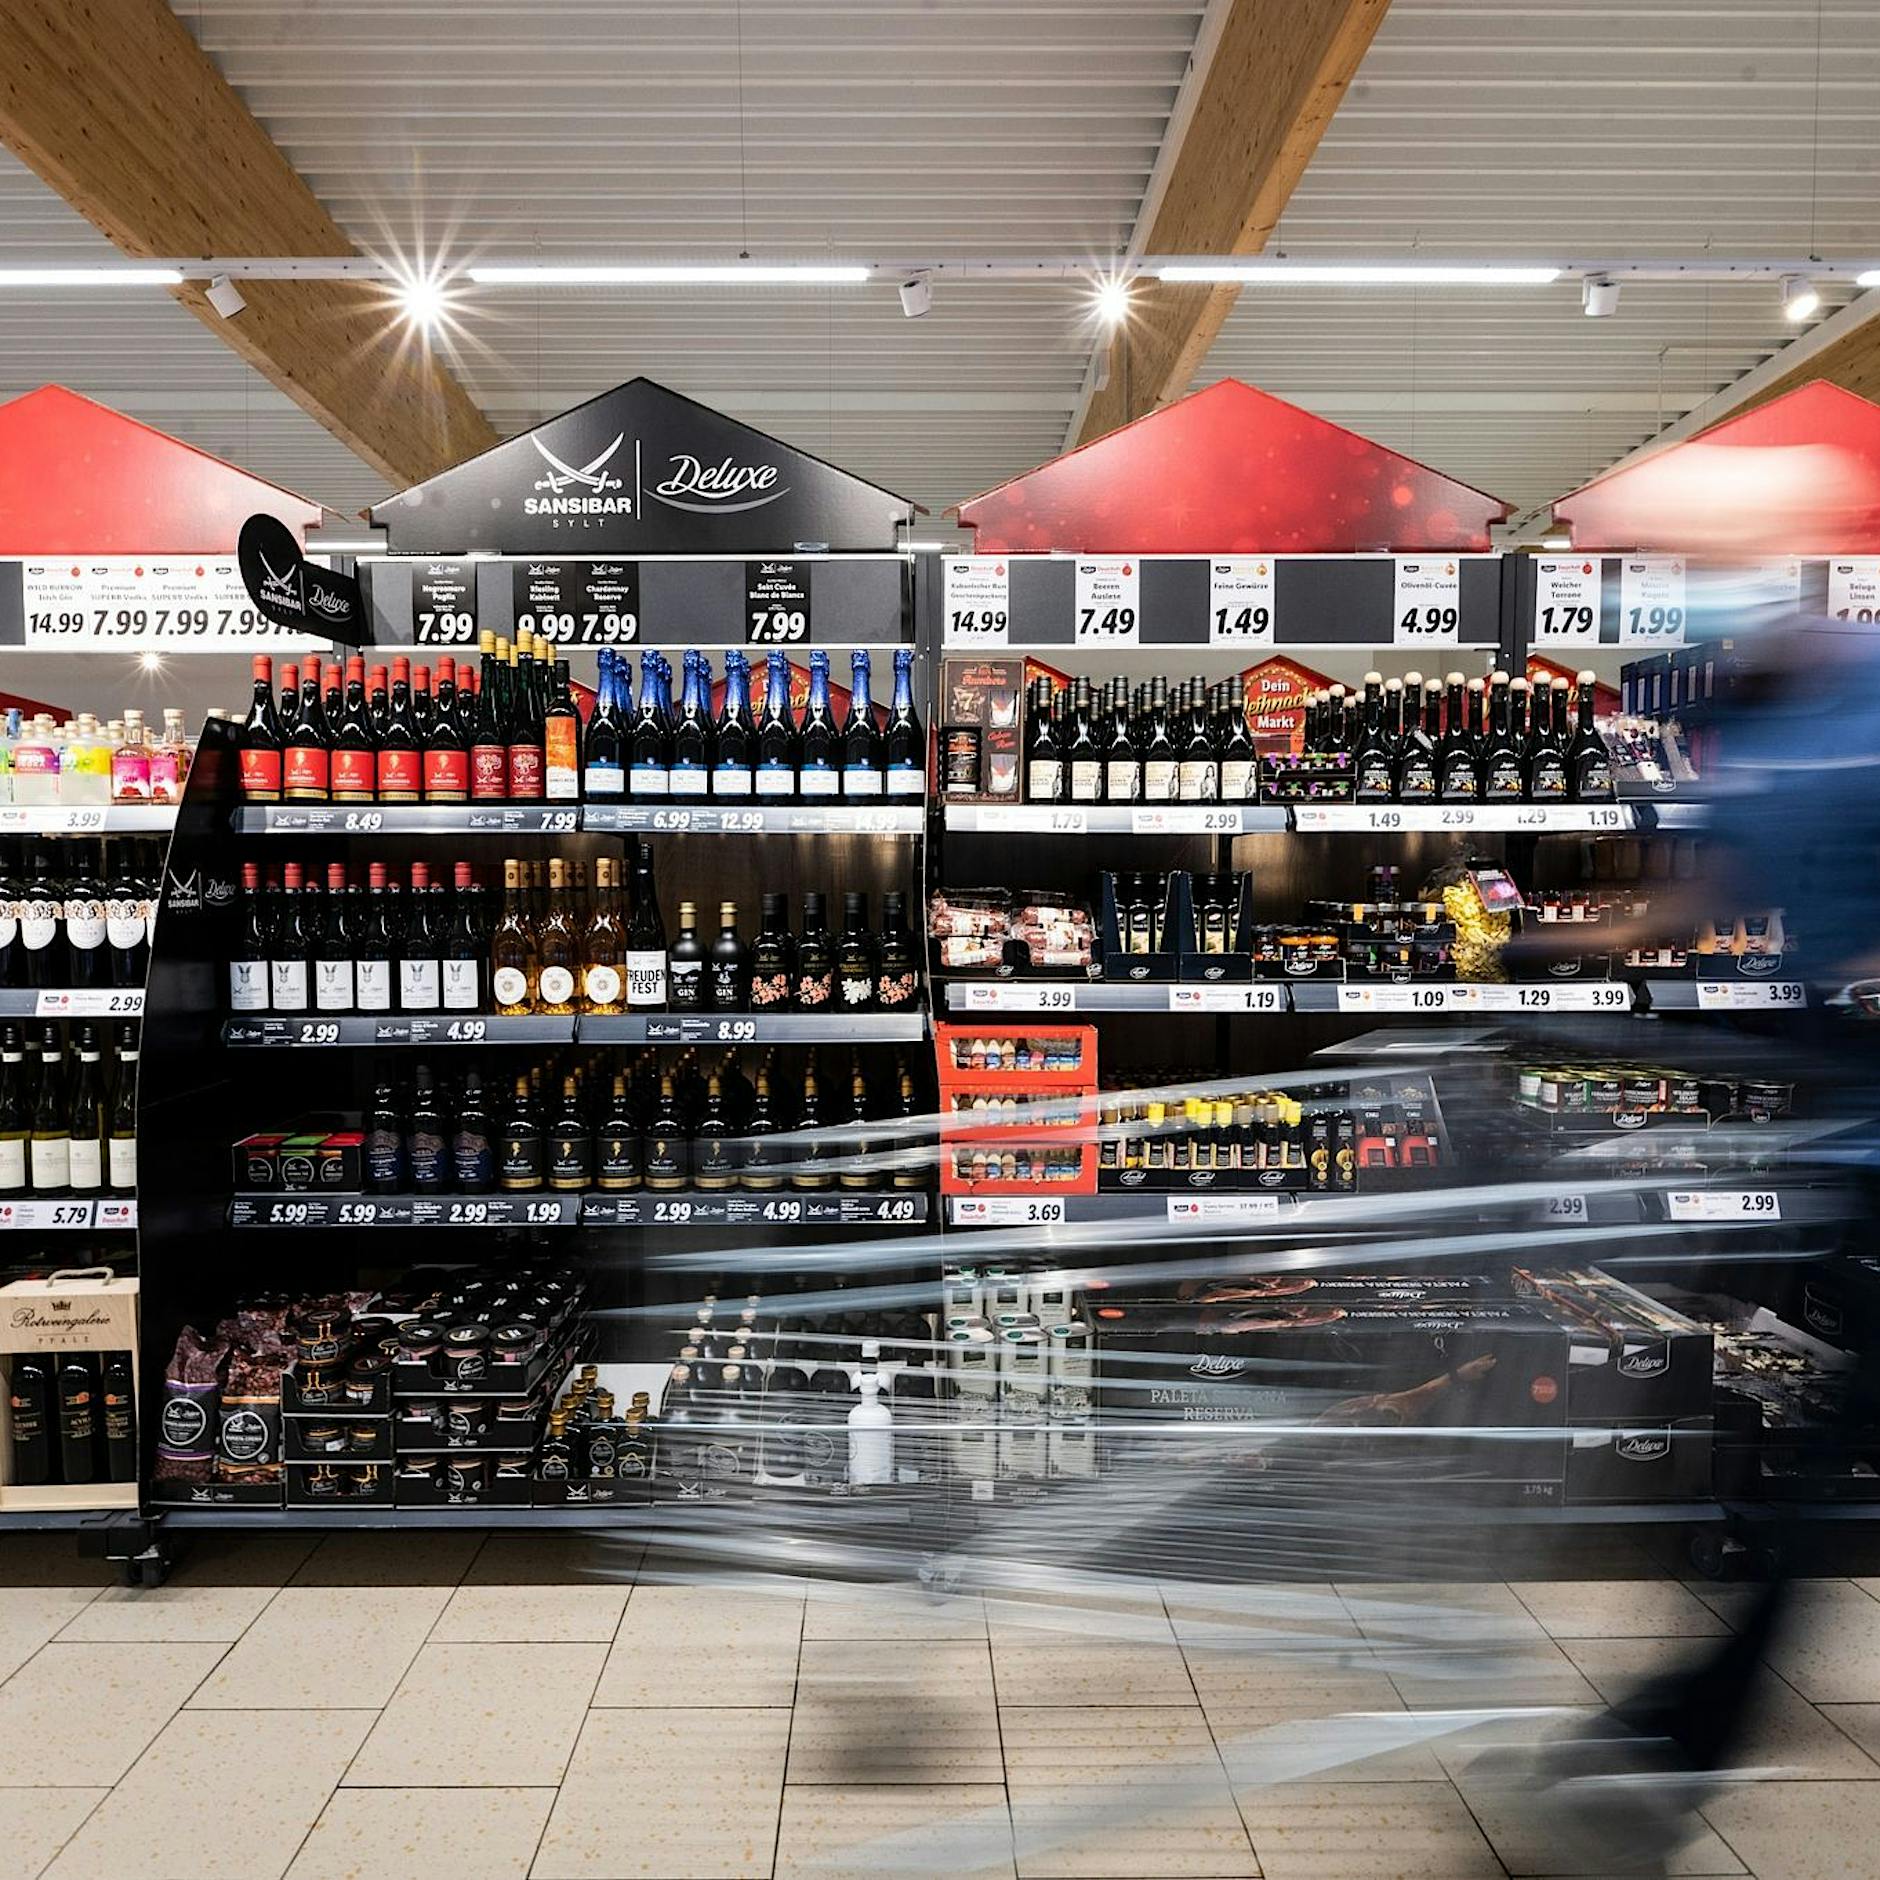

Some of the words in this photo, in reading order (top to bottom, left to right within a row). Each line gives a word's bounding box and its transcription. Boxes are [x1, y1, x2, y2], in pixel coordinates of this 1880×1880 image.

[656, 454, 778, 499] Deluxe
[524, 497, 632, 515] SANSIBAR
[552, 518, 605, 528] SYLT
[585, 585, 629, 594] Chardonnay
[749, 591, 768, 599] Blanc
[769, 591, 779, 599] de
[1235, 582, 1269, 591] Gewürze
[1850, 583, 1876, 592] Beluga
[260, 588, 301, 610] SANSIBAR
[309, 584, 350, 613] Deluxe
[1091, 592, 1122, 600] Auslese
[29, 612, 84, 633] 14.99
[93, 610, 148, 636] 7.99
[155, 610, 209, 636] 7.99
[217, 610, 270, 636] 7.99
[418, 613, 474, 642] 7.99
[518, 613, 575, 642] 999
[581, 613, 637, 642] 7.99
[750, 612, 806, 641] 7.99
[952, 610, 1007, 633] 14.99
[1080, 608, 1135, 634] 7.49
[1216, 608, 1269, 634] 1.49
[1400, 607, 1457, 634] 4.99
[1541, 607, 1593, 634] 1.79
[1629, 607, 1683, 634] 1.99
[1262, 679, 1290, 693] Dein
[1257, 714, 1295, 729] Markt
[67, 812, 101, 827] 3.99
[345, 812, 382, 830] 8.49
[540, 812, 576, 831] 7.99
[653, 811, 690, 829] 6.99
[720, 812, 764, 830] 12.99
[1051, 813, 1083, 829] 1.79
[1204, 813, 1237, 828] 2.99
[1369, 813, 1400, 828] 1.49
[1441, 811, 1474, 825] 2.99
[1588, 811, 1619, 826] 1.19
[627, 968, 666, 982] REUDEN
[632, 981, 658, 994] FEST
[677, 987, 696, 996] GIN
[716, 987, 733, 996] GIN
[1769, 984, 1801, 1001] 3.99
[109, 996, 143, 1011] 2.99
[1039, 991, 1071, 1007] 3.99
[1244, 991, 1275, 1008] 1.19
[1412, 990, 1444, 1007] 1.09
[1518, 989, 1550, 1006] 1.29
[1592, 990, 1624, 1006] 3.99
[300, 1023, 339, 1043] 2.99
[446, 1020, 486, 1040] 4.99
[717, 1020, 755, 1040] 8.99
[762, 1201, 801, 1220] 4.99
[876, 1200, 914, 1219] 4.49
[1549, 1197, 1583, 1214] 2.99
[1741, 1195, 1775, 1211] 2.99
[53, 1207, 87, 1224] 5.79
[270, 1204, 308, 1223] 5.99
[338, 1203, 376, 1223] 5.99
[449, 1203, 487, 1223] 2.99
[526, 1203, 562, 1222] 1.99
[653, 1202, 692, 1222] 2.99
[1027, 1204, 1061, 1221] 3.69
[10, 1307, 111, 1333] Rotweingalerie
[38, 1335, 89, 1344] PFALZ
[1190, 1354, 1245, 1374] Deluxe
[1627, 1353, 1664, 1370] Deluxe
[1151, 1389, 1208, 1404] PALETA
[1184, 1406, 1256, 1421] RESERVA
[1624, 1438, 1664, 1453] Deluxe
